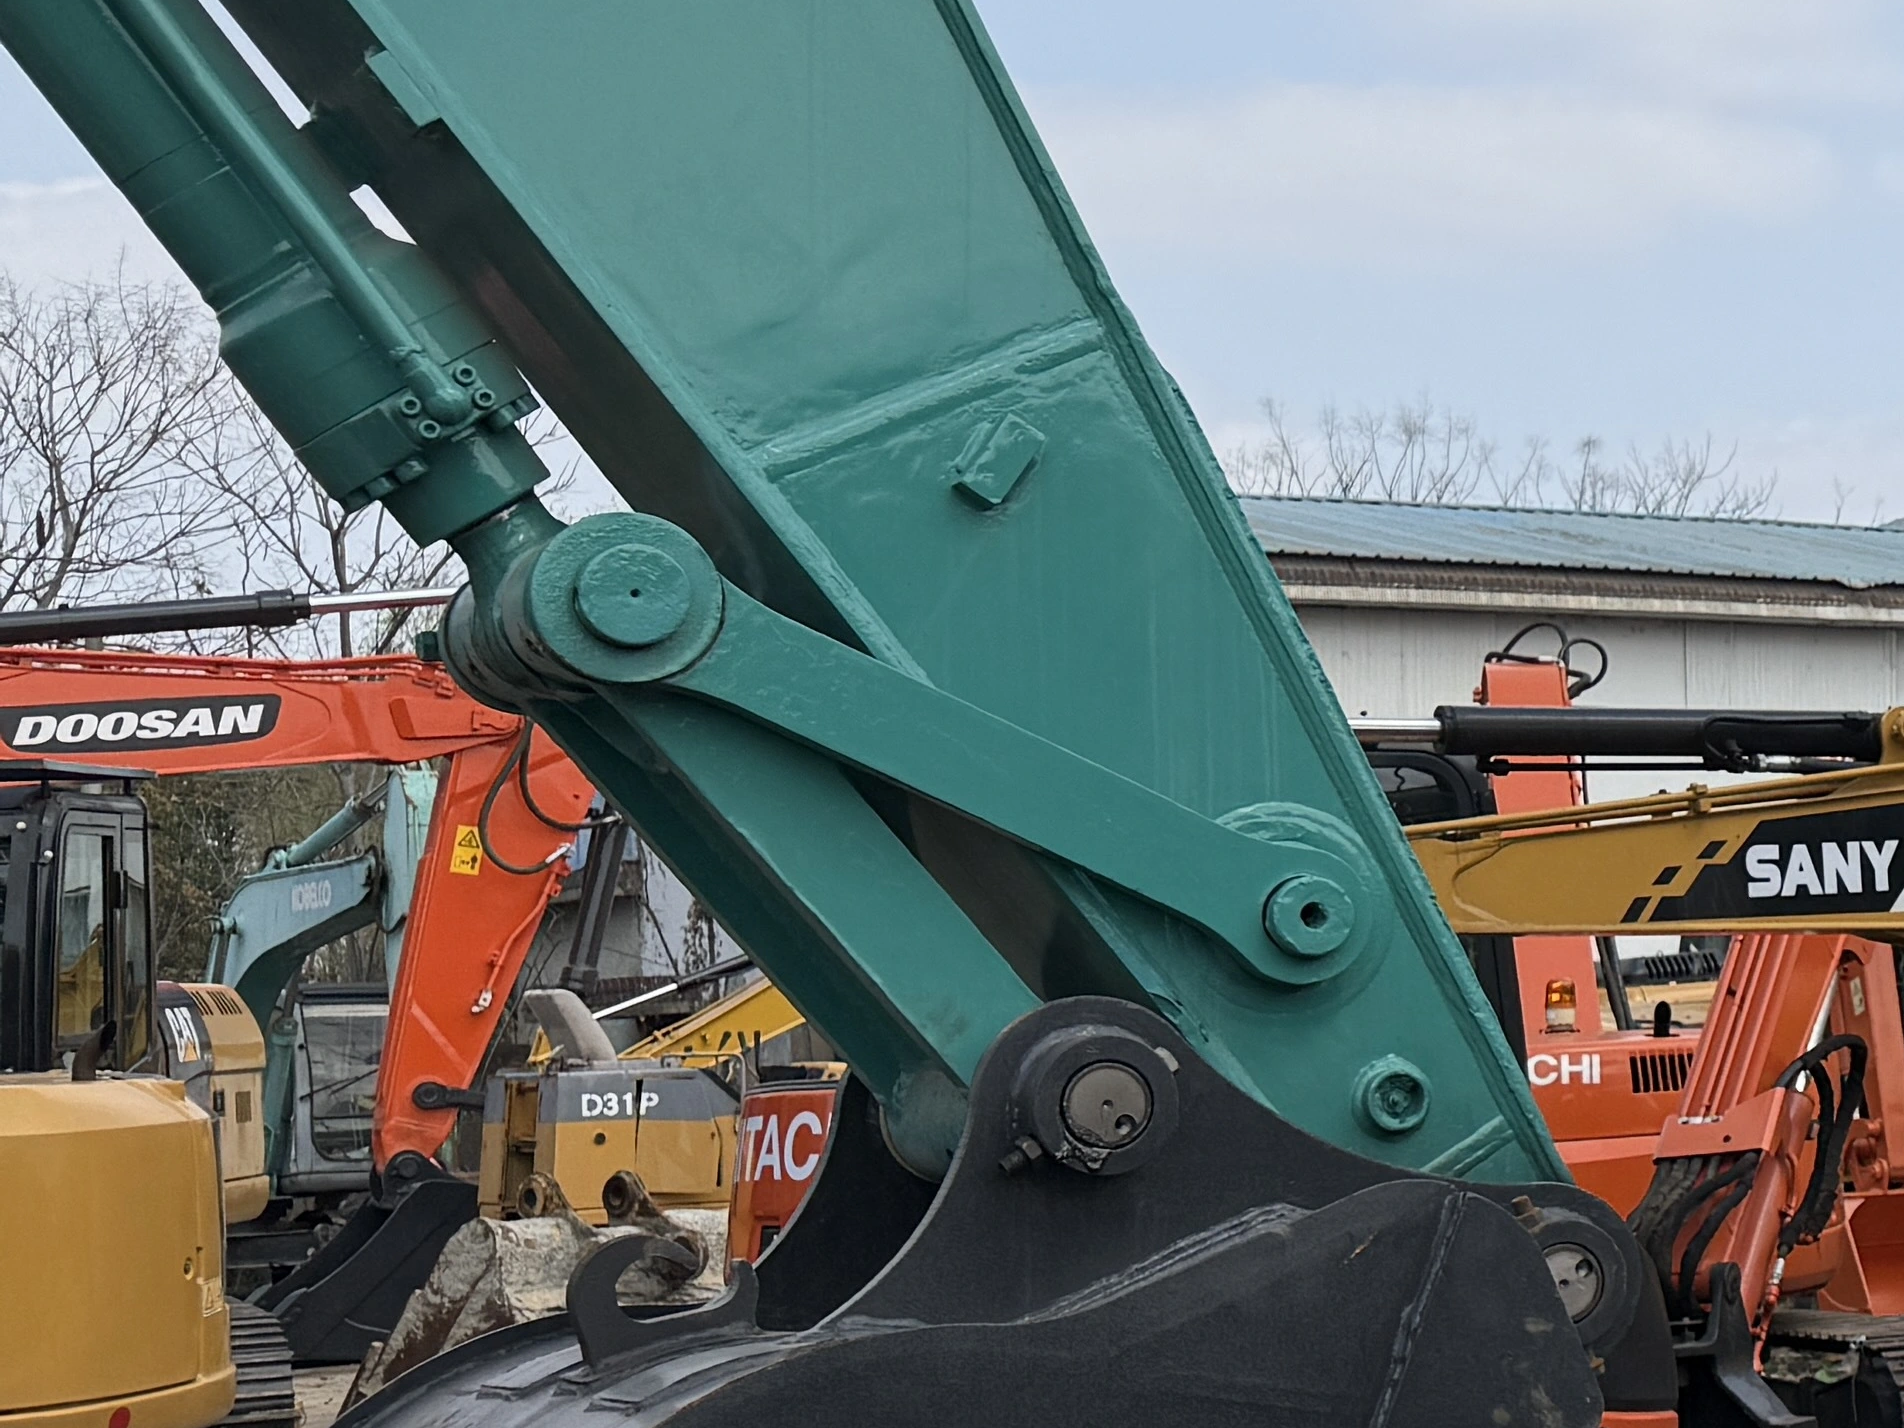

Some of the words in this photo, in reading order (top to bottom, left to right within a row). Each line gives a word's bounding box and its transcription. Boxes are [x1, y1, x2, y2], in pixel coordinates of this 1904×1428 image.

[12, 704, 264, 746] DOOSAN
[1745, 839, 1900, 898] SANY
[164, 1006, 201, 1063] CAT
